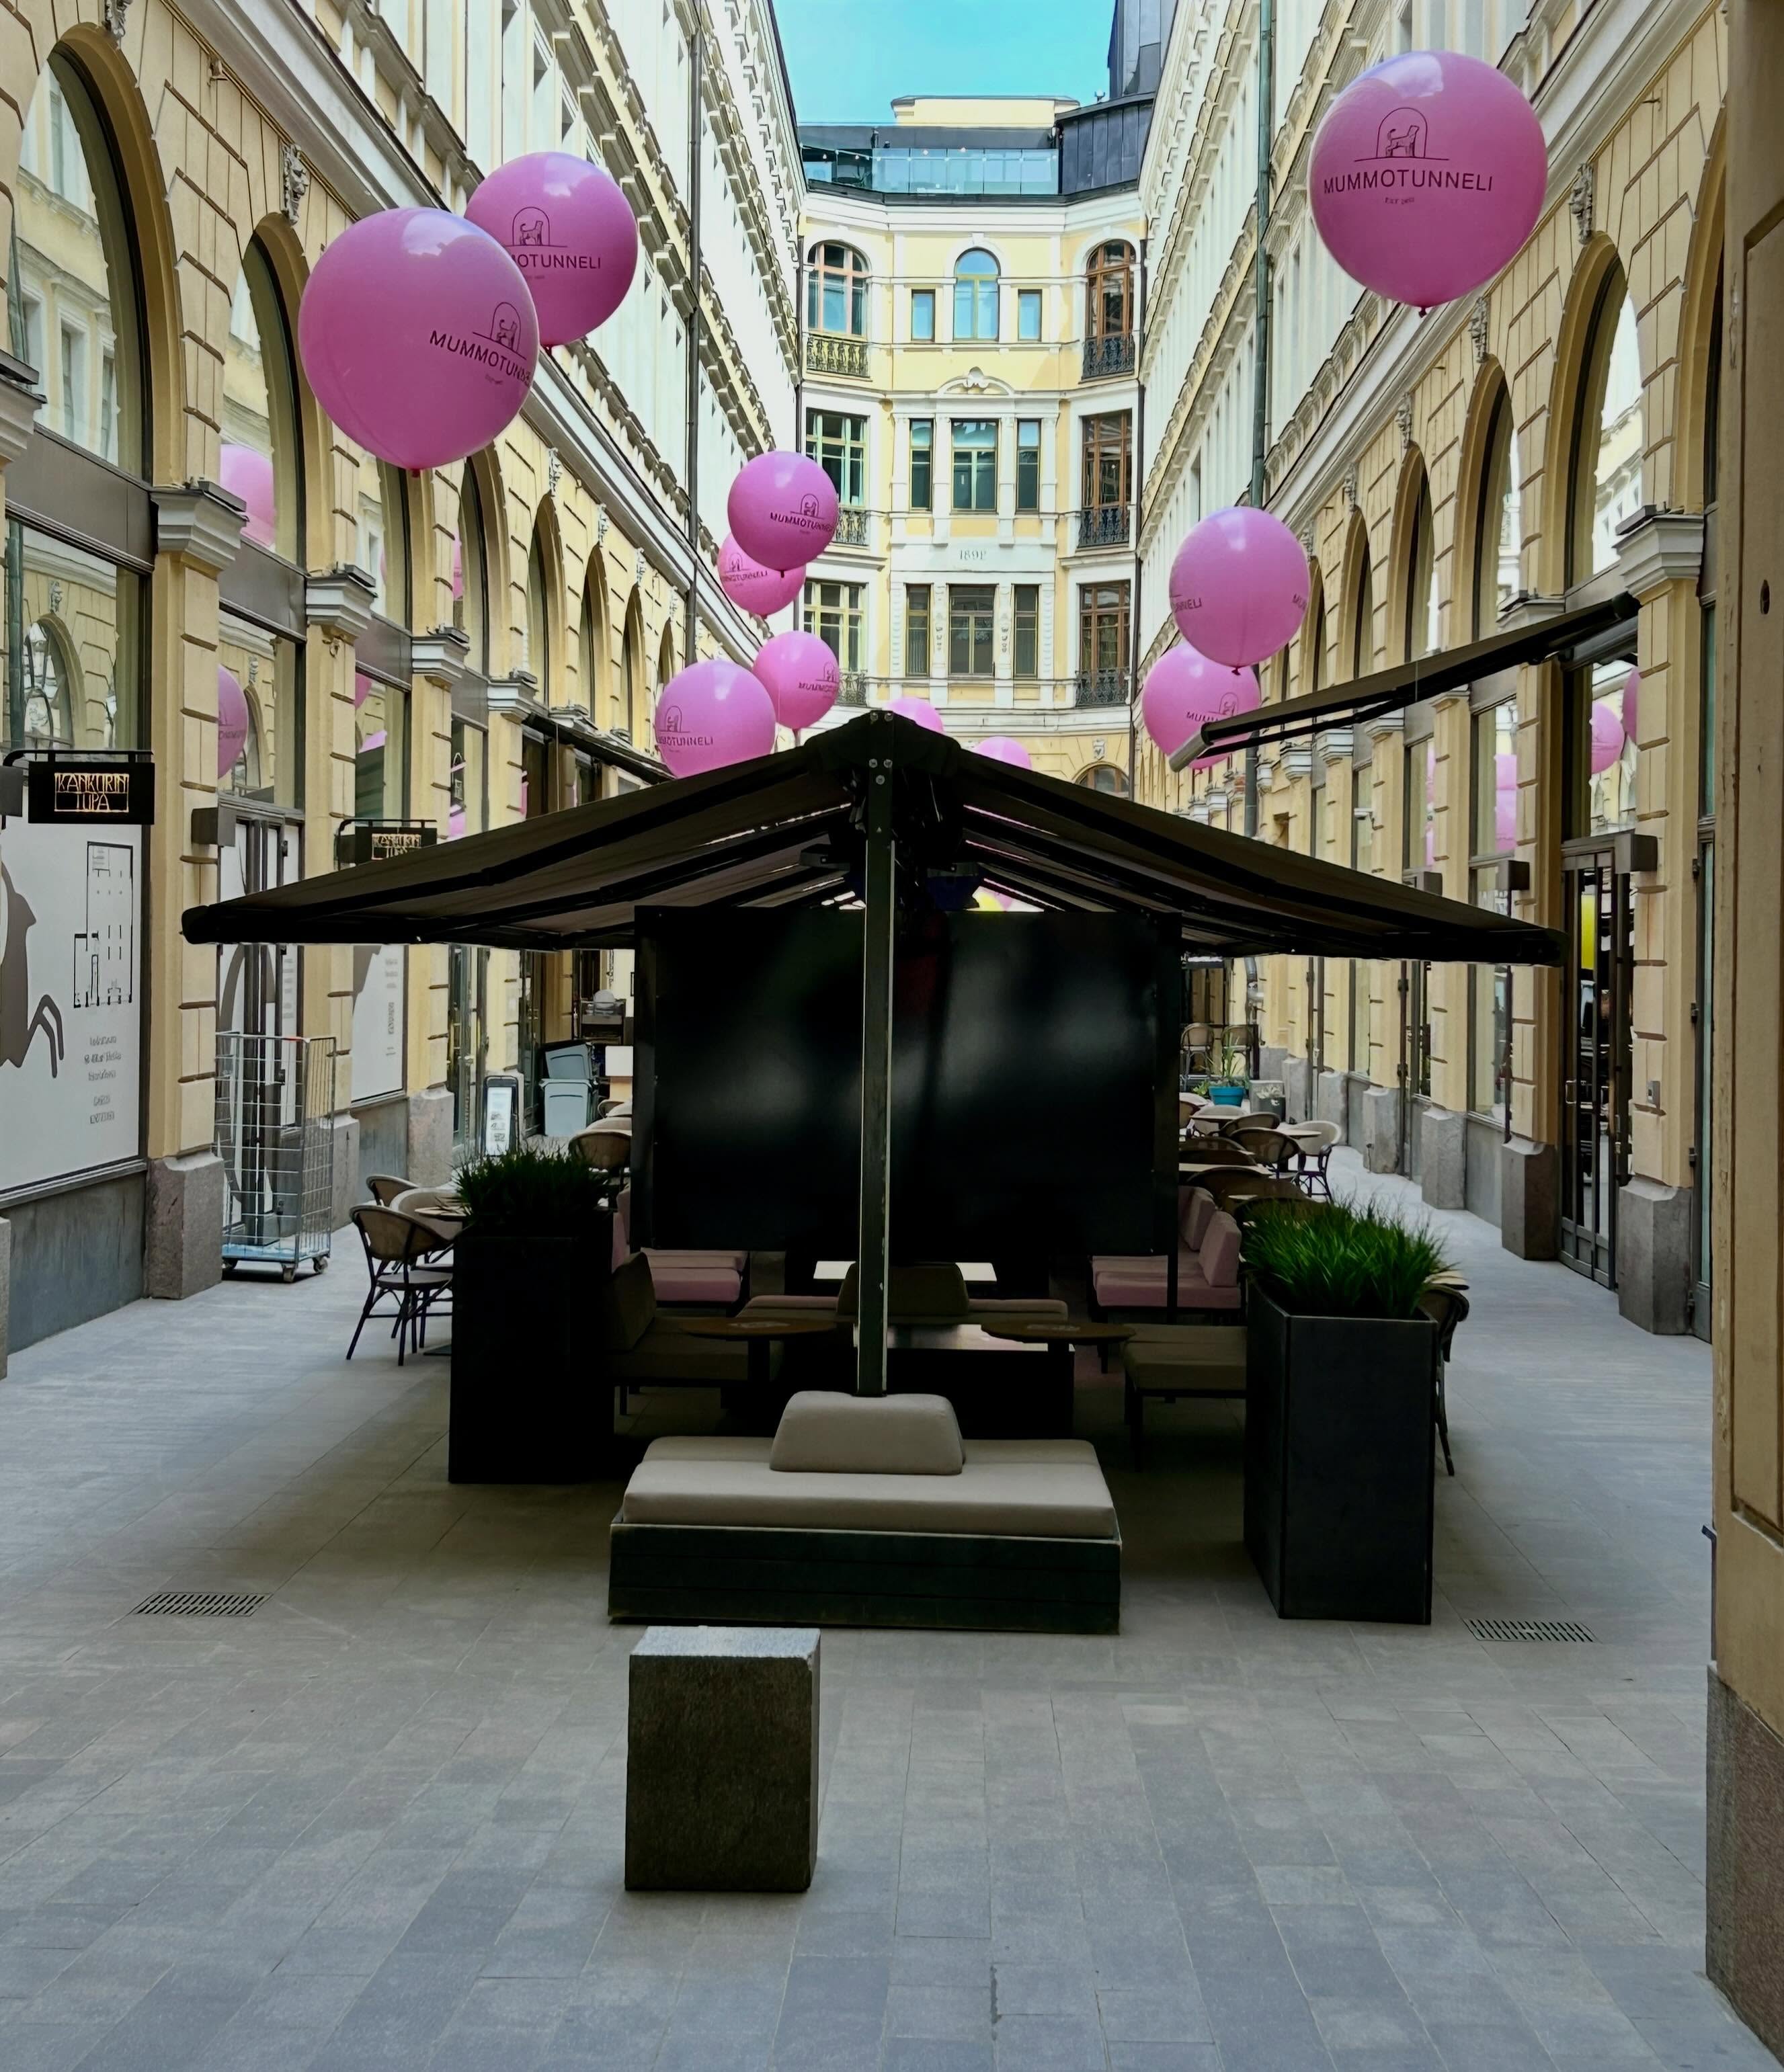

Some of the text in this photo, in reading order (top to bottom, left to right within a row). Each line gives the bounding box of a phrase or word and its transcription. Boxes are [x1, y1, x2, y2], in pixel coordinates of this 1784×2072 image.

[1324, 169, 1492, 194] MUMMOTUNNELI
[512, 253, 601, 270] OTUNNELI
[430, 330, 531, 388] MUMMOTUN
[54, 773, 129, 794] KANKURIN
